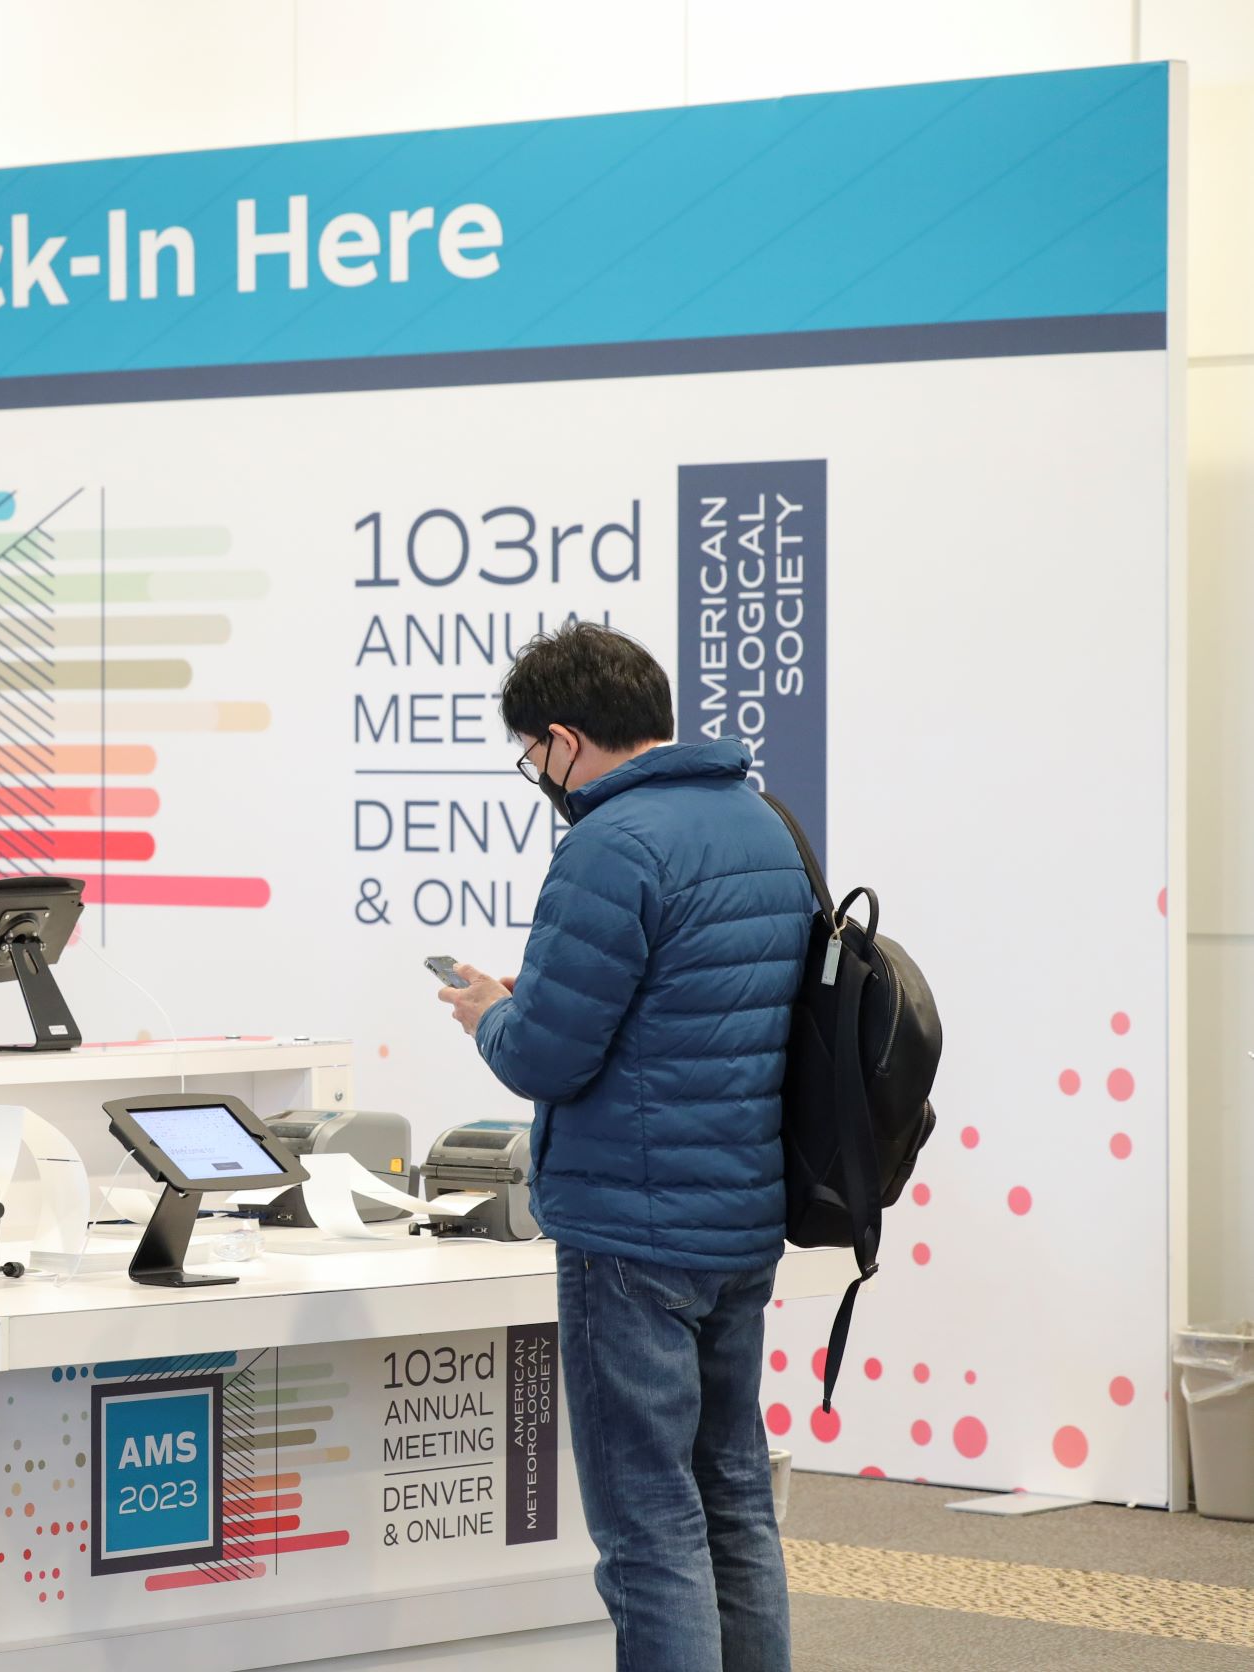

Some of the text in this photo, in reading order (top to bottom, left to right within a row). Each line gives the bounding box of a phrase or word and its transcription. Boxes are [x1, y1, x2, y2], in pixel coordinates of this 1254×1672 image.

[236, 194, 504, 293] Here
[354, 499, 641, 588] 103rd
[700, 496, 728, 741] AMERICAN
[775, 493, 804, 696] SOCIETY
[355, 610, 611, 667] ANNU
[737, 493, 766, 793] ROLOGICAL
[354, 877, 391, 925] &
[383, 1341, 495, 1389] 103rd
[514, 1339, 525, 1447] AMERICAN
[540, 1337, 551, 1424] SOCIETY
[384, 1391, 494, 1426] ANNUAL
[527, 1337, 538, 1530] METEOROLOGICAL
[118, 1430, 197, 1470] AMS
[383, 1427, 494, 1462] MEETING
[118, 1479, 198, 1515] 2023
[383, 1475, 493, 1513] DENVER
[383, 1511, 493, 1546] & ONLINE
